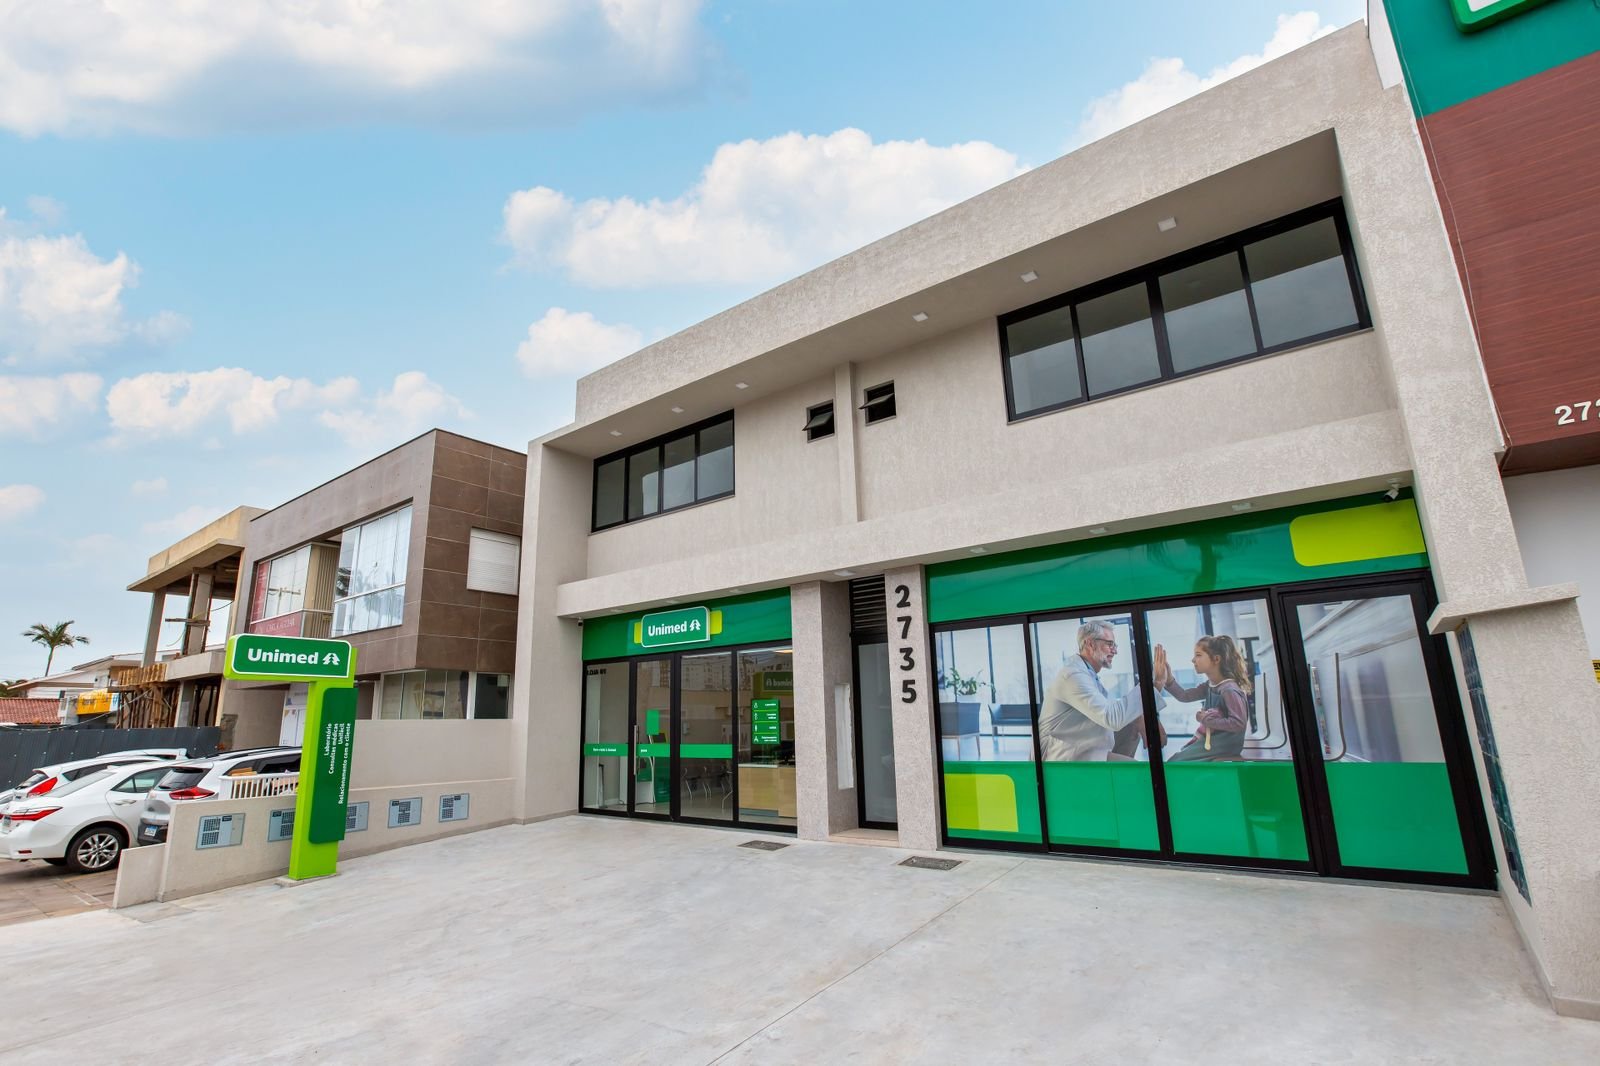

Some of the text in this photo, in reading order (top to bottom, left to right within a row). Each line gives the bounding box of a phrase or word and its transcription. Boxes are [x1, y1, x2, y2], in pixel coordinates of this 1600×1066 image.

[647, 621, 687, 637] Unimed
[894, 584, 917, 704] 2735
[247, 647, 319, 665] Unimed
[324, 723, 332, 756] Laboratório
[328, 723, 339, 774] Consultas médicas
[338, 759, 348, 804] Relacionamento
